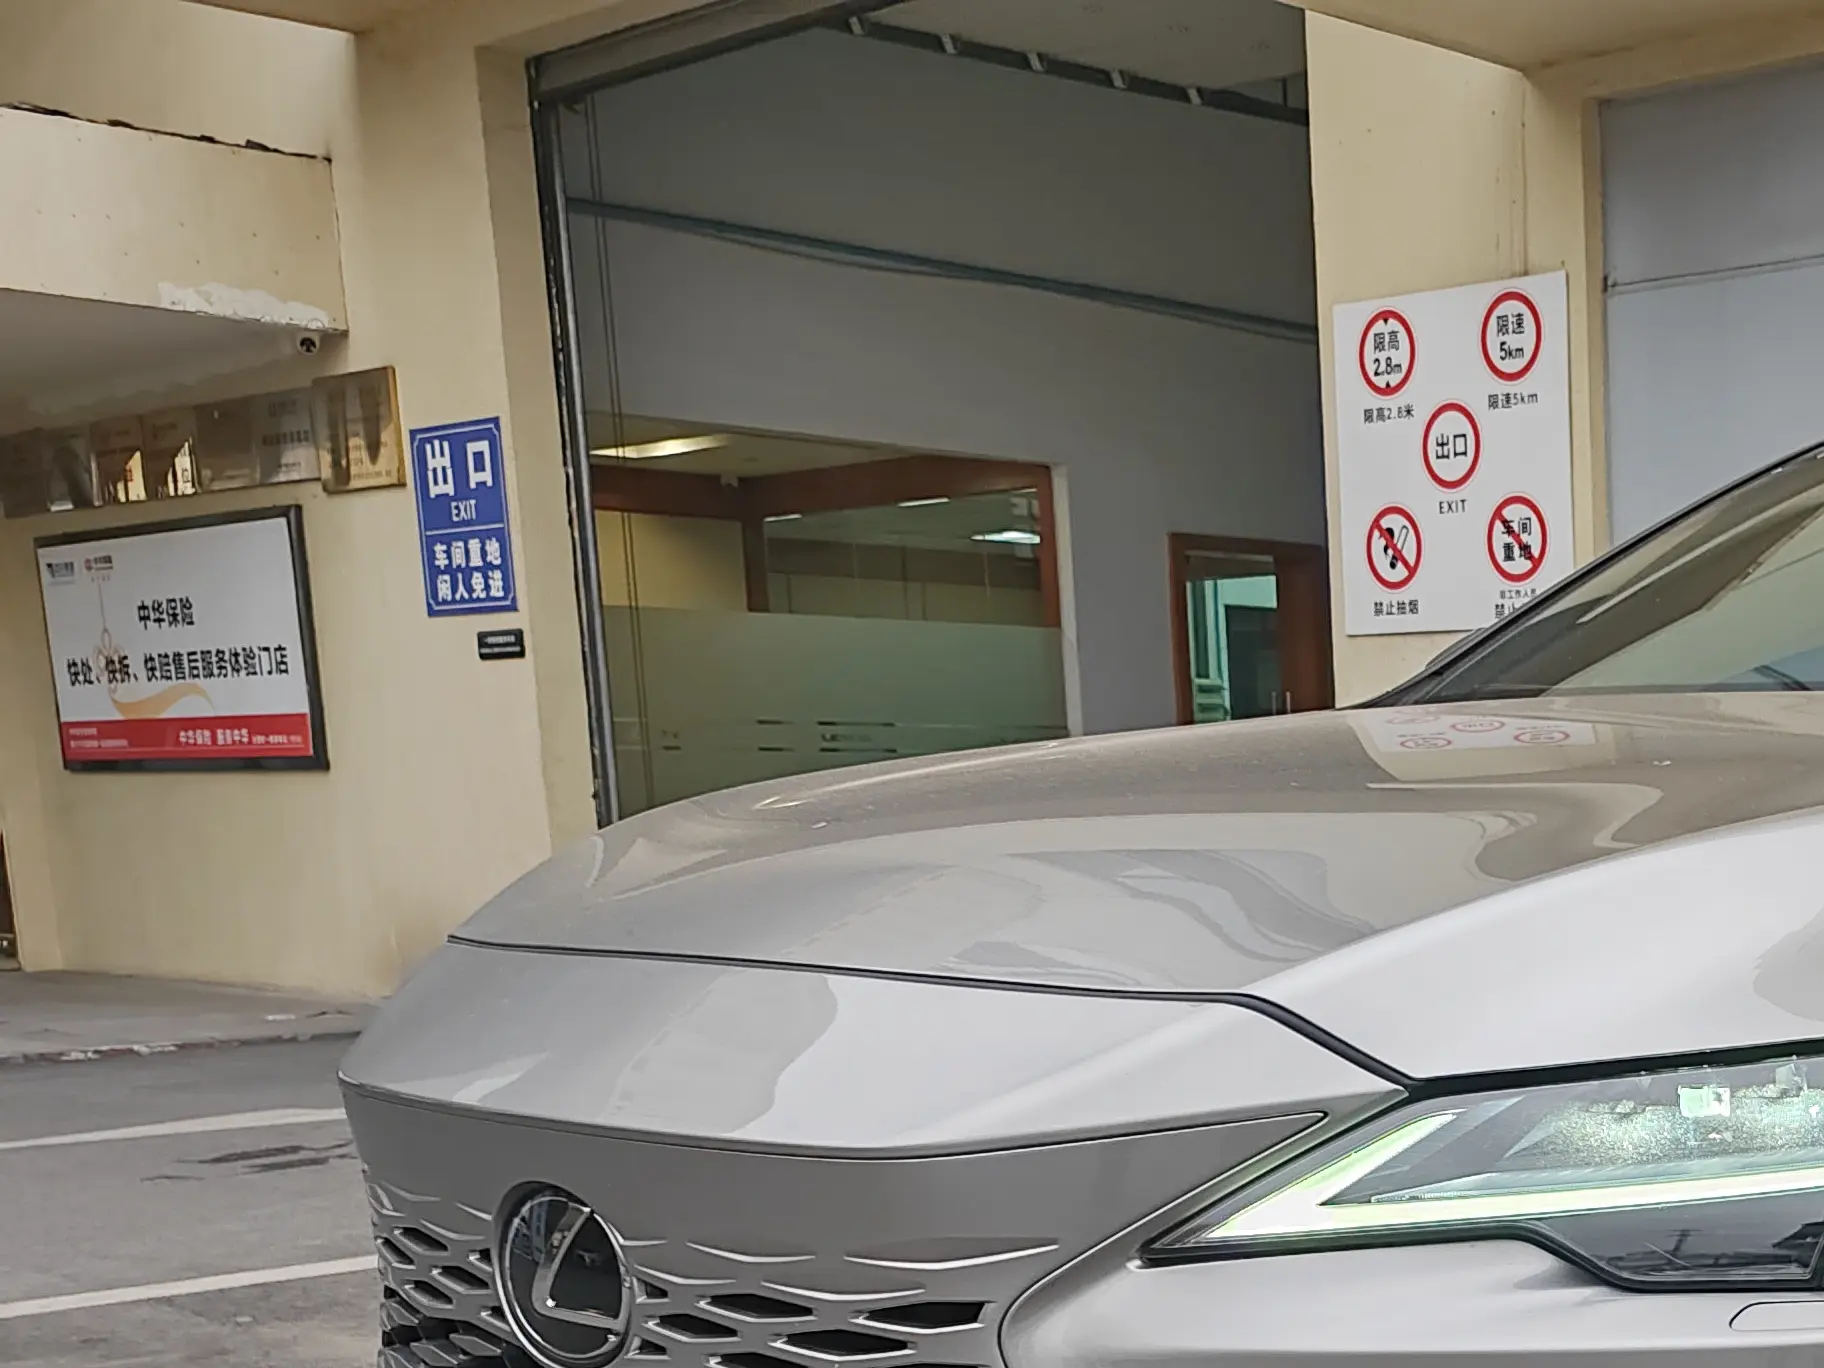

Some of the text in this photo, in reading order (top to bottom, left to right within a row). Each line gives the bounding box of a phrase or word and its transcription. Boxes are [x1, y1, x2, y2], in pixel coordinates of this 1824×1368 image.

[1496, 312, 1525, 338] 限速
[1373, 330, 1400, 354] 限高
[1499, 341, 1524, 361] 5km
[1373, 356, 1403, 377] 2.8m
[1488, 392, 1538, 411] 限速5km
[1363, 404, 1415, 424] 限高2.8米
[1435, 433, 1468, 460] 出口
[424, 439, 494, 499] 出口
[451, 499, 477, 522] EXIT
[1438, 499, 1468, 515] EXIT
[1501, 517, 1532, 537] 车间
[433, 537, 502, 570] 车间重地
[1502, 541, 1533, 563] 重地
[436, 570, 505, 602] 闲人免进
[137, 596, 195, 630] 中华保险
[1373, 599, 1419, 617] 禁止抽烟
